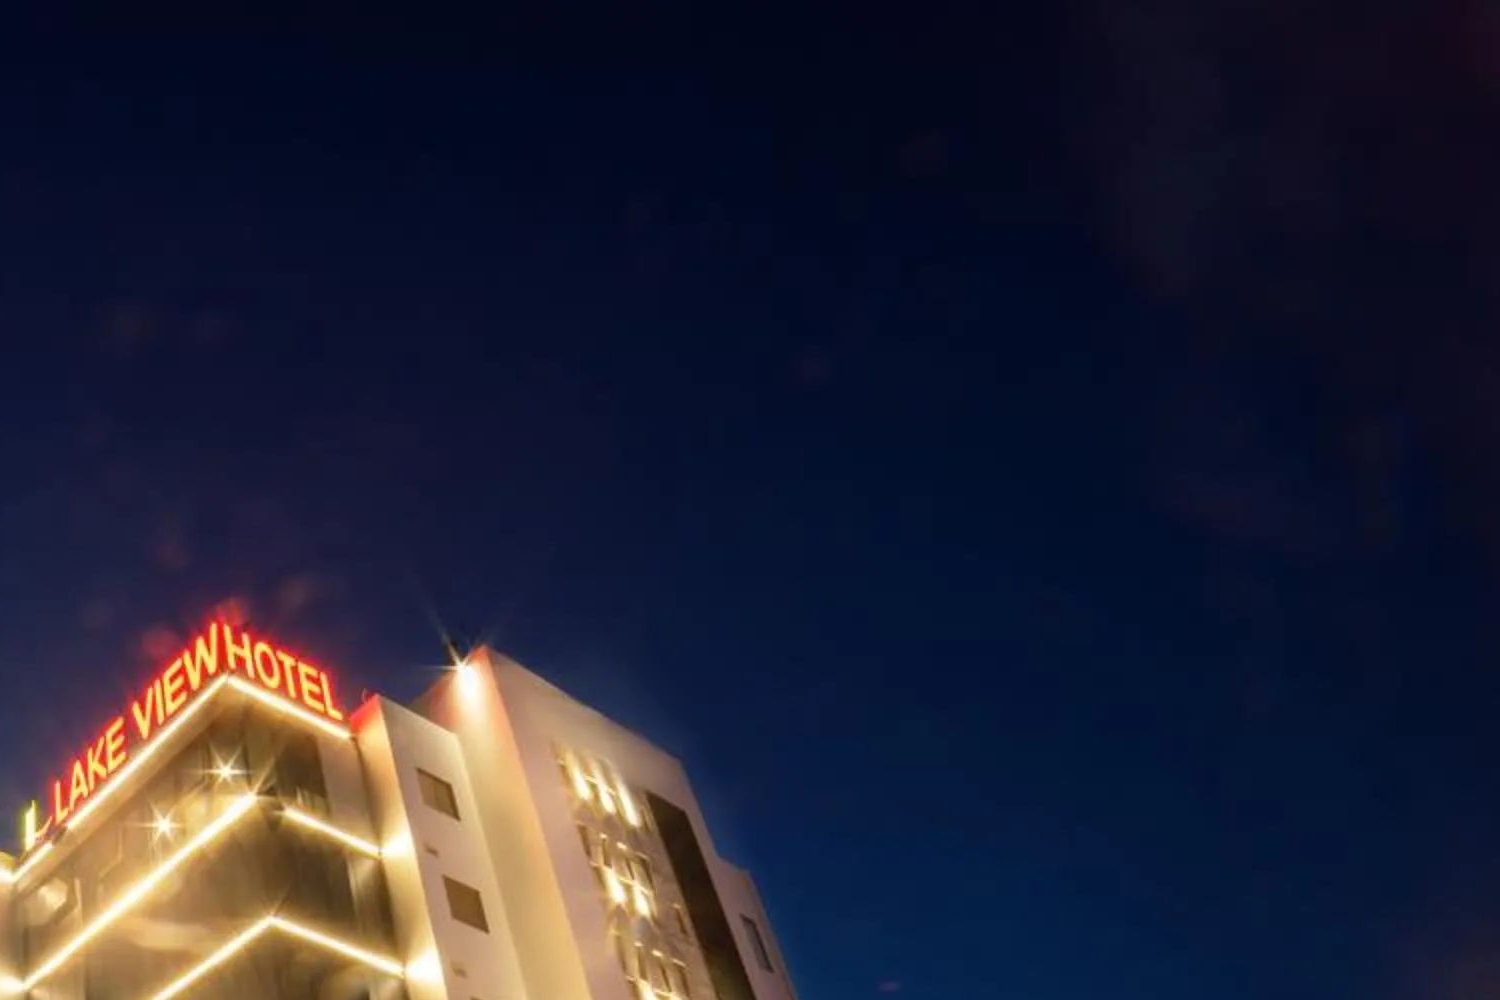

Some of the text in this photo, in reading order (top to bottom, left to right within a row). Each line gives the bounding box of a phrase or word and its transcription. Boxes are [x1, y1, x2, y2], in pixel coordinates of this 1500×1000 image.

[54, 623, 344, 824] LAKE VIEW HOTEL
